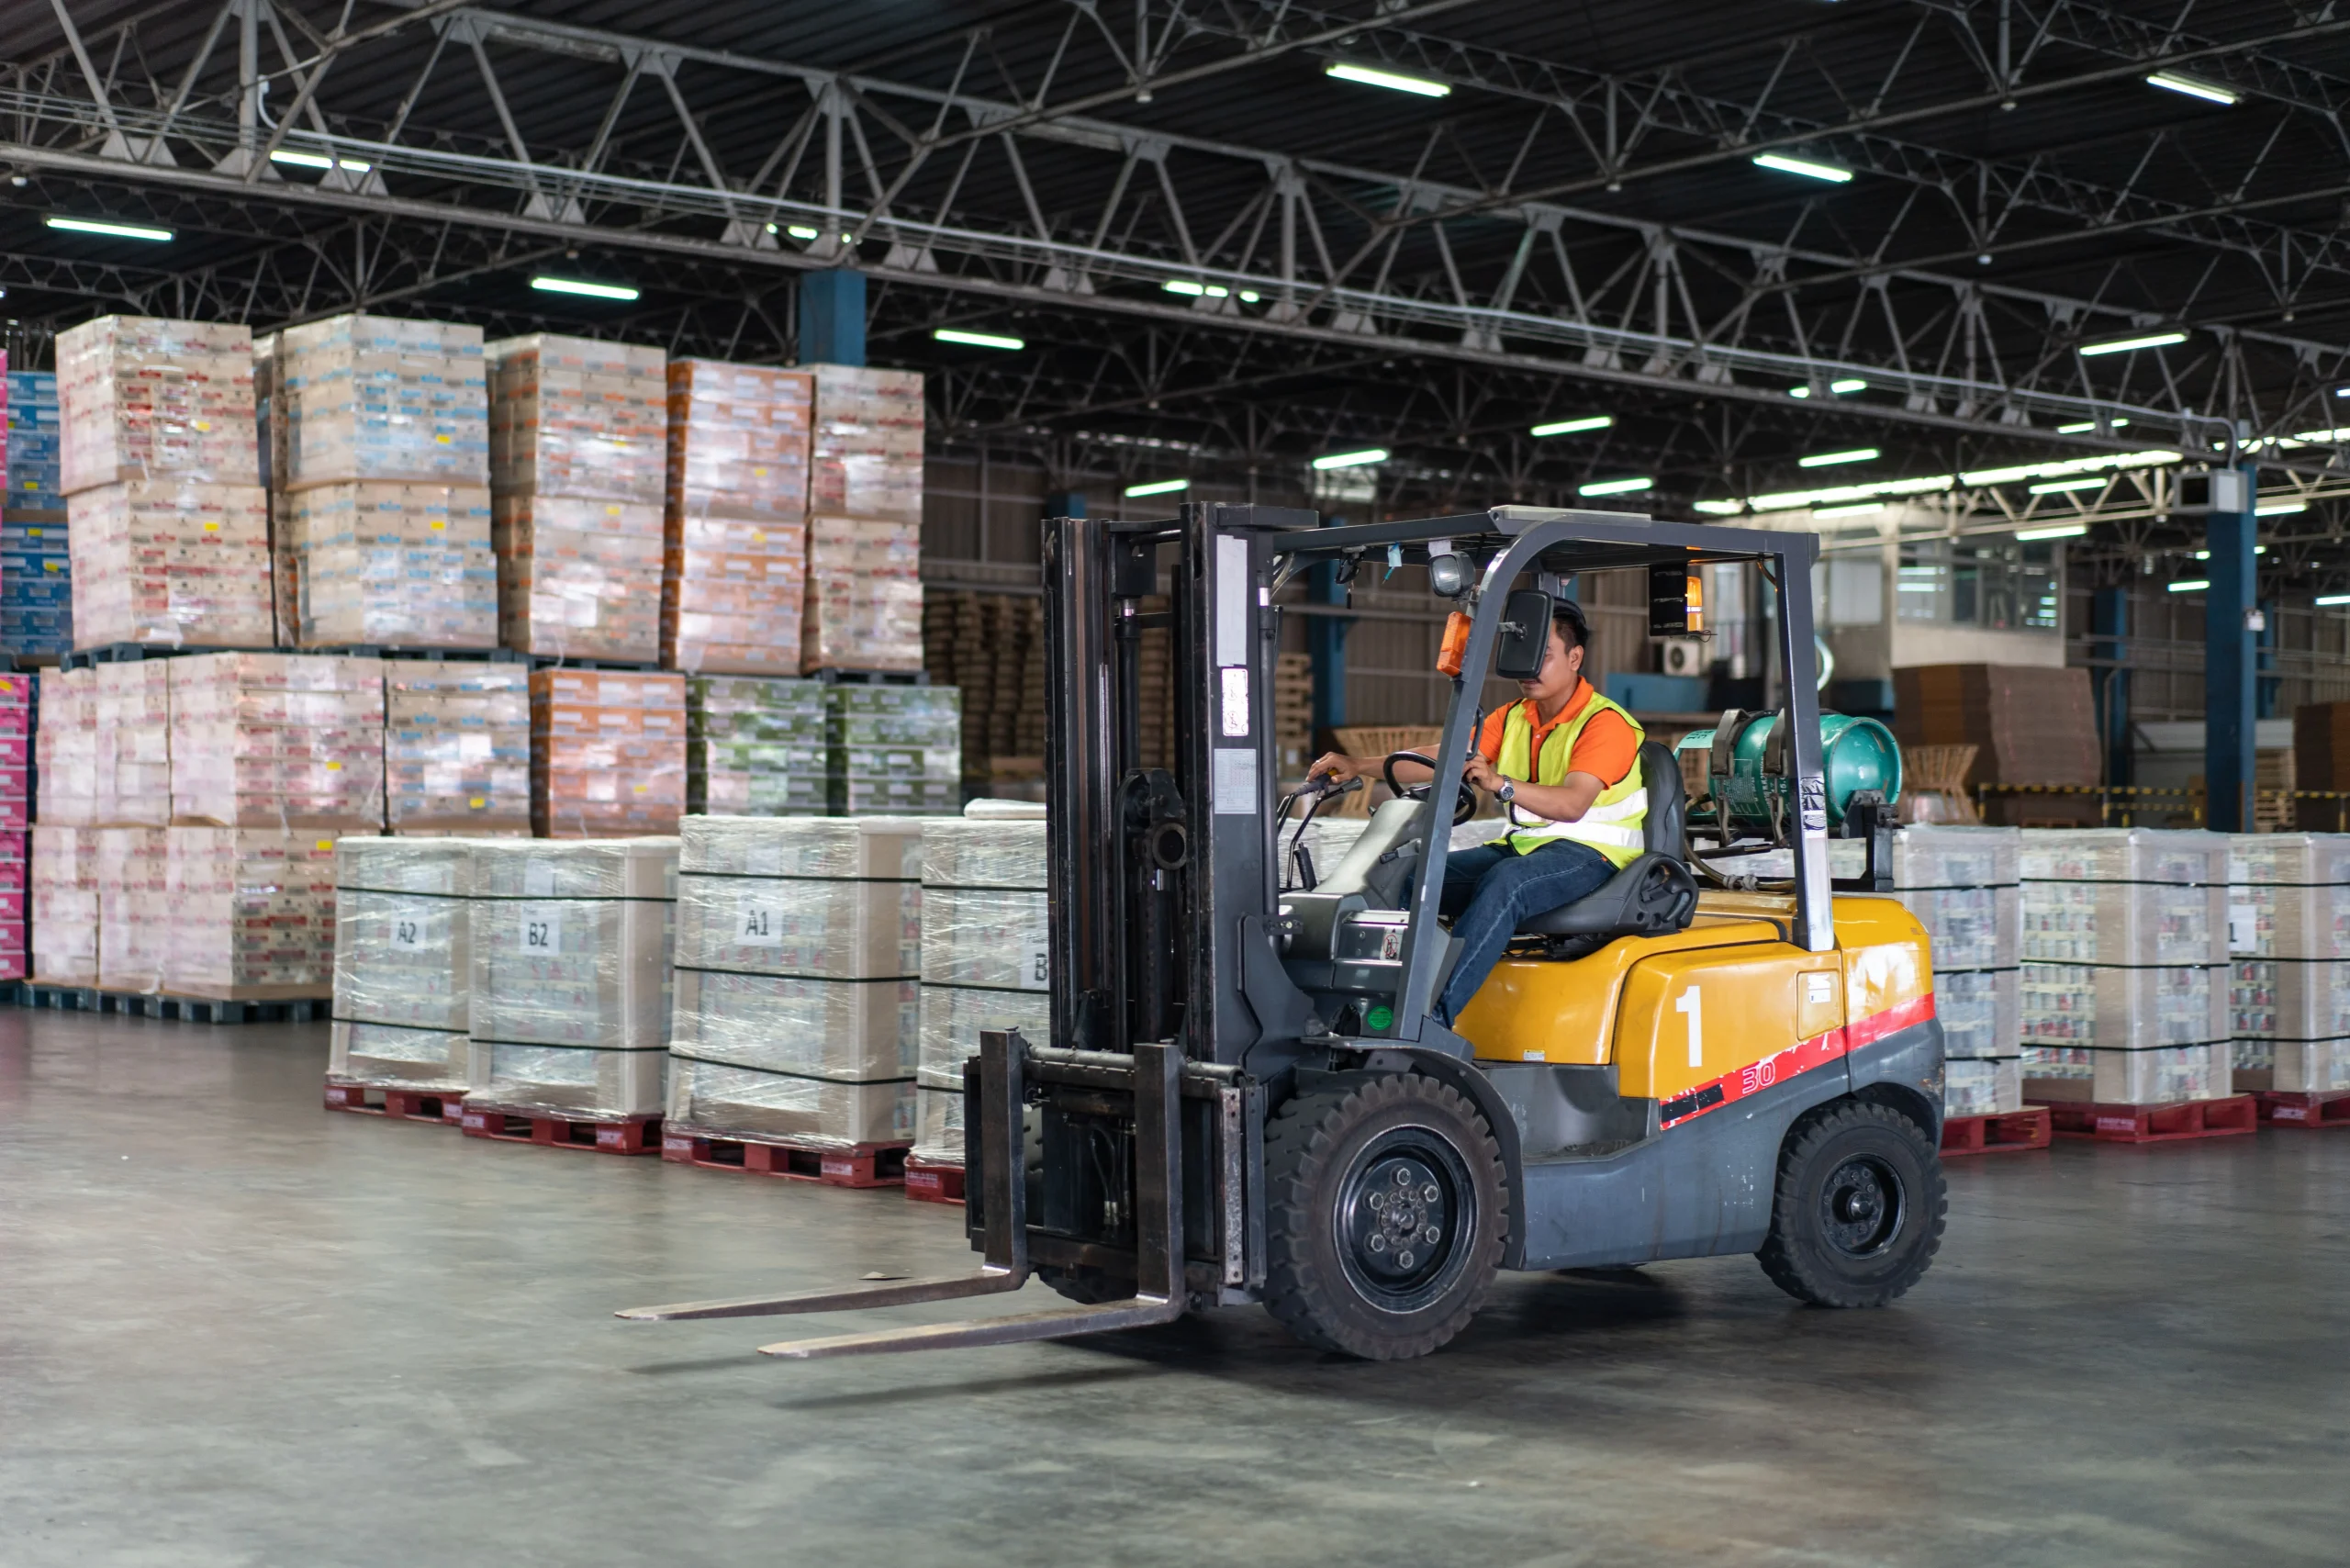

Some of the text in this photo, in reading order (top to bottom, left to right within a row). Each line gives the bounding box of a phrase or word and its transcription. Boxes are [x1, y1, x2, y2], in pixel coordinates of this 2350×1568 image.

[397, 921, 417, 944] A2
[529, 922, 548, 946] B2
[744, 910, 768, 936] A1
[1675, 985, 1703, 1068] 1
[1741, 1060, 1776, 1094] 30
